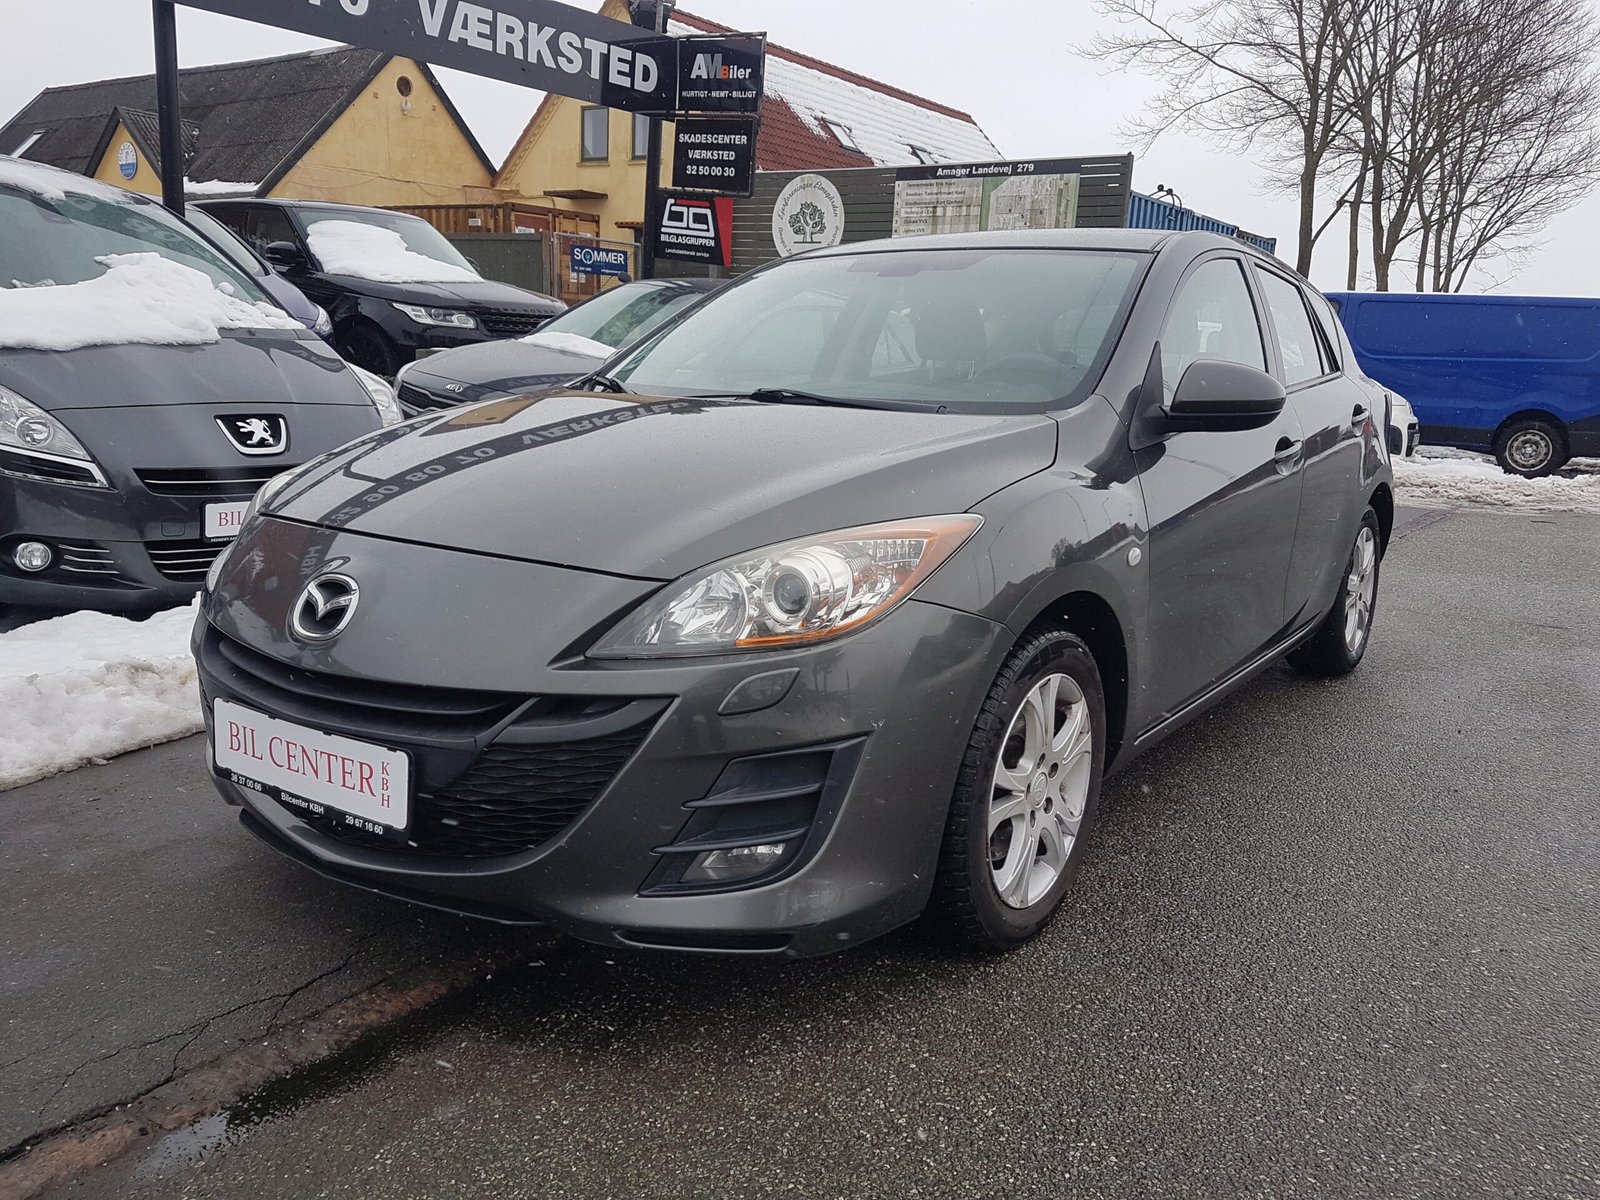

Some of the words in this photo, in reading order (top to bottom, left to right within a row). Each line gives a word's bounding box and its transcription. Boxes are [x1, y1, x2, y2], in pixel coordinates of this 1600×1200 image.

[418, 0, 658, 93] VÆRKSTED
[690, 53, 752, 79] AMBiler
[679, 133, 748, 144] SKADESCENTER
[688, 149, 736, 160] VÆRKSTED
[937, 167, 970, 176] Amager
[972, 164, 1012, 174] Landevej
[1017, 163, 1034, 172] 279
[660, 234, 715, 247] BILGLASGRUPPEN
[574, 248, 624, 265] SOMMER
[228, 720, 263, 761] BIL
[269, 736, 377, 798] CENTER
[280, 792, 308, 809] Bilcenter
[309, 802, 324, 815] KBH
[345, 815, 354, 825] 29
[374, 825, 384, 835] 60
